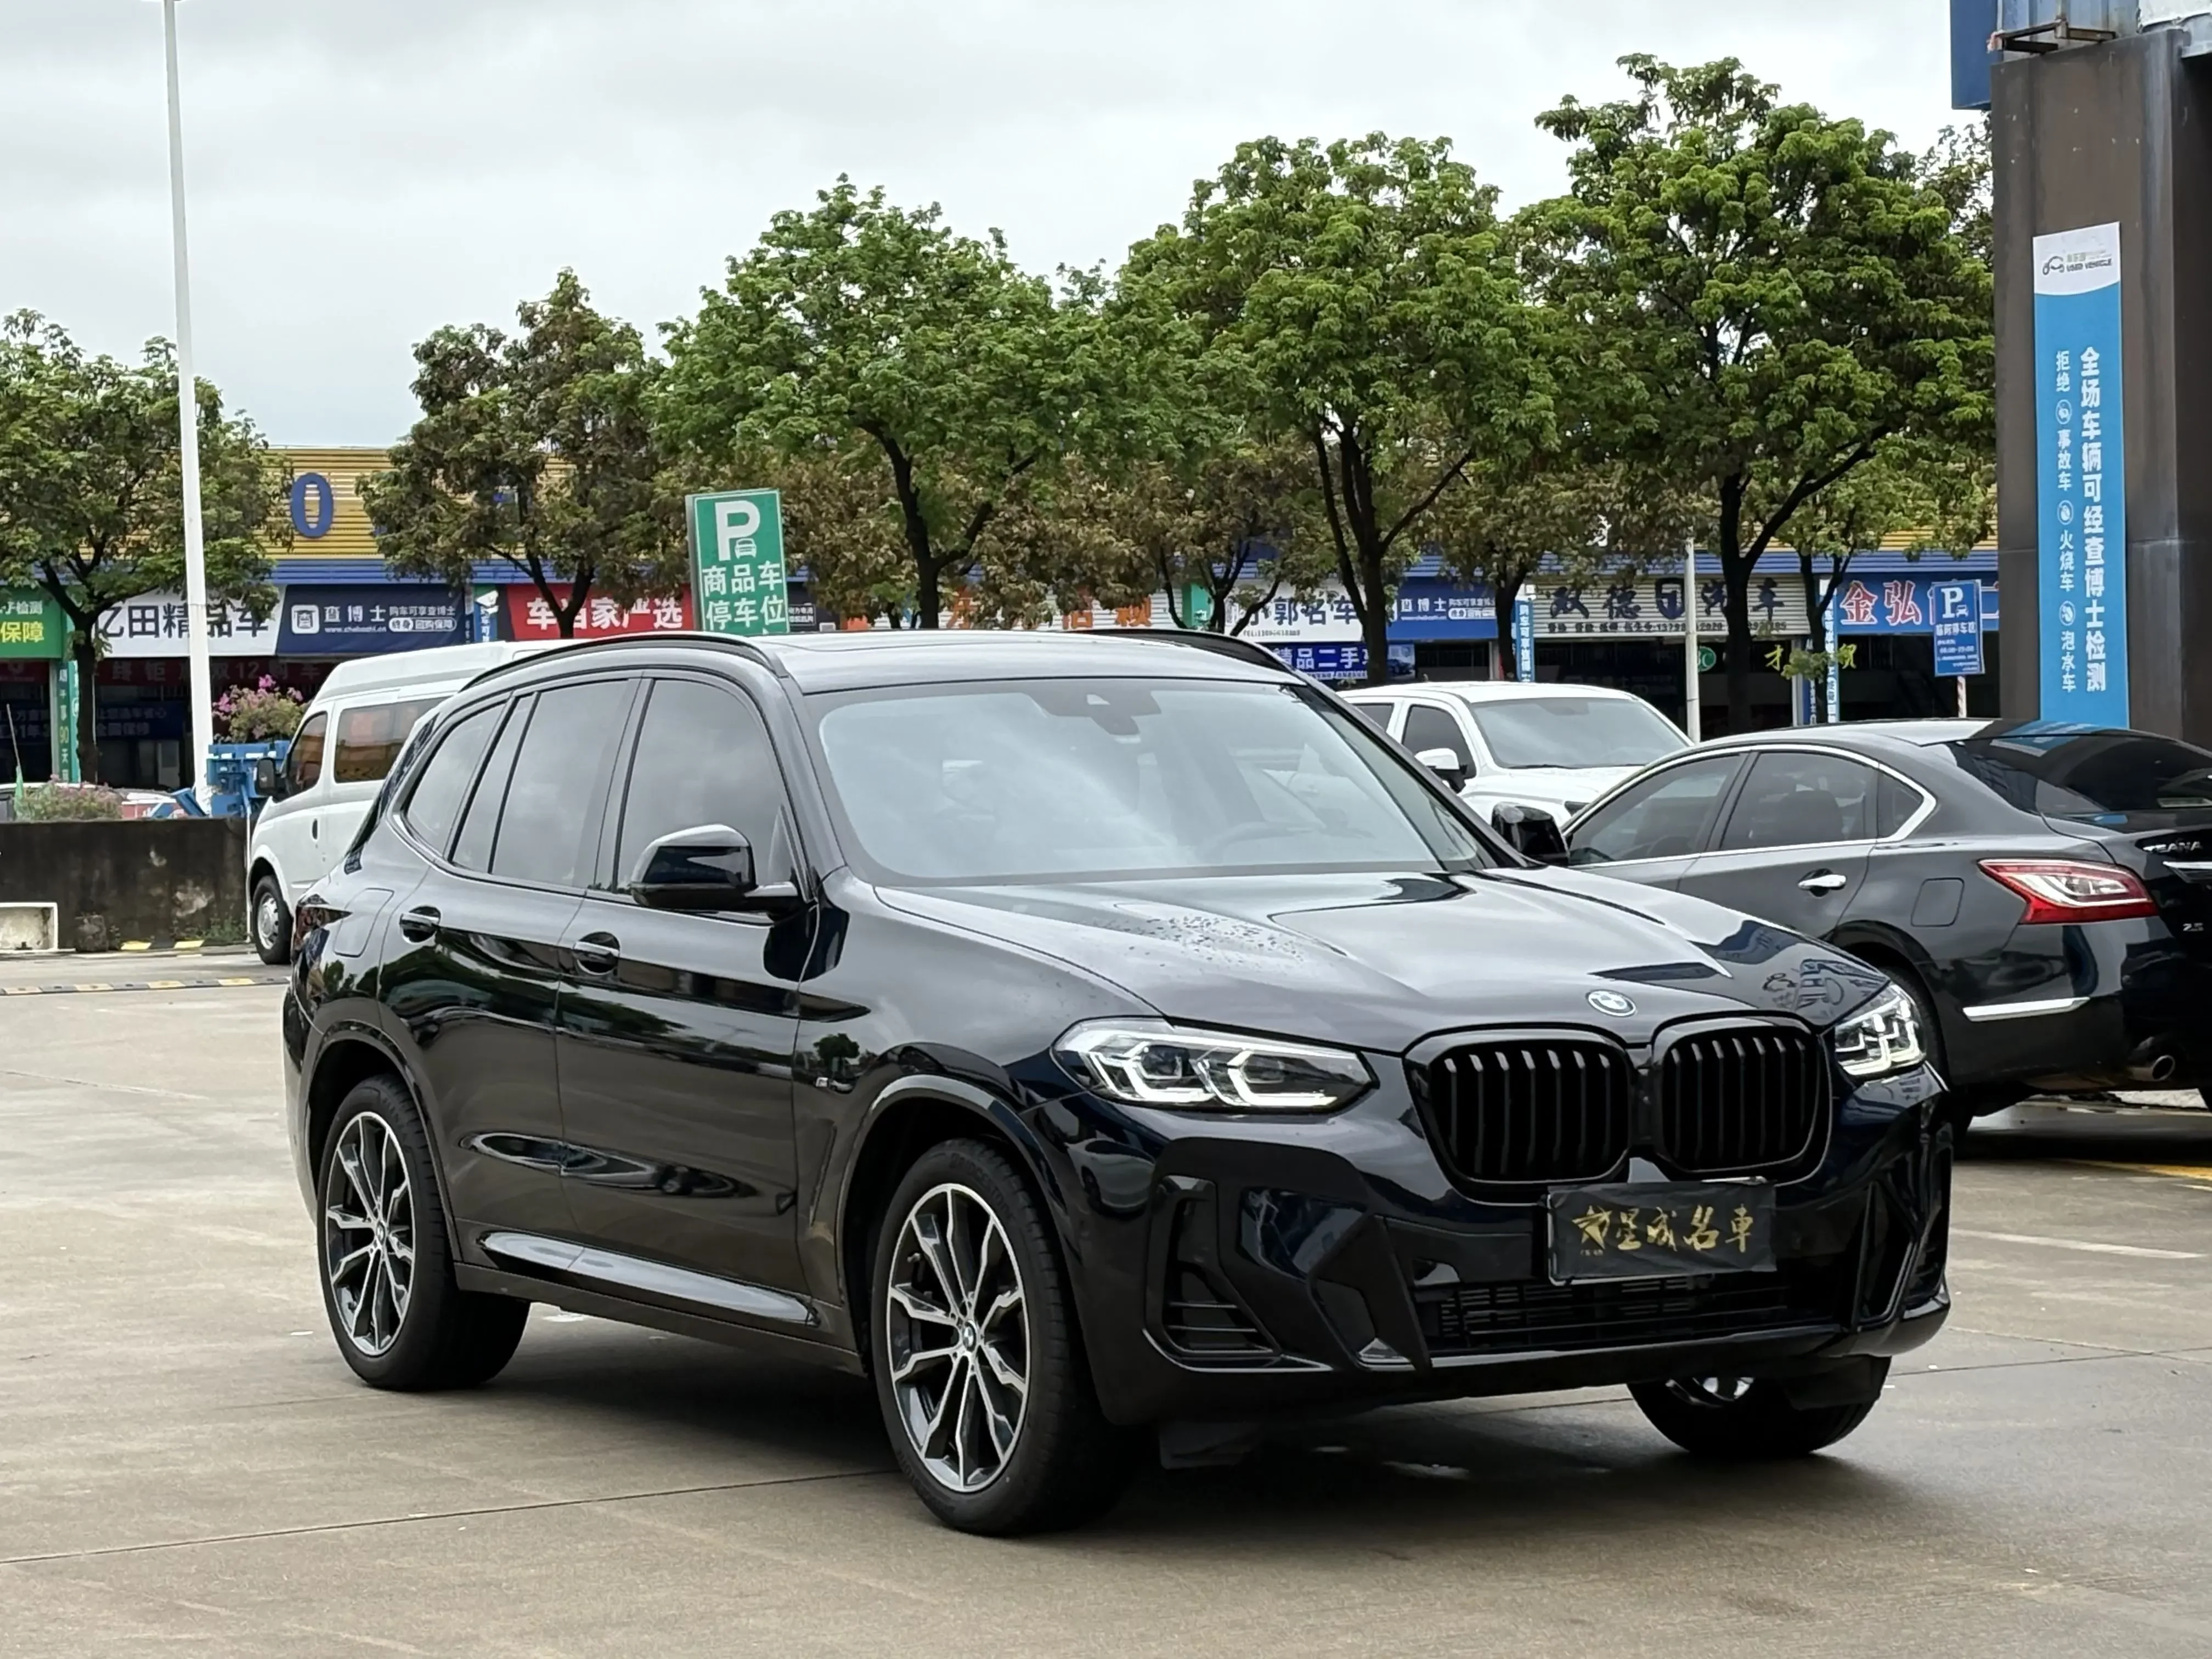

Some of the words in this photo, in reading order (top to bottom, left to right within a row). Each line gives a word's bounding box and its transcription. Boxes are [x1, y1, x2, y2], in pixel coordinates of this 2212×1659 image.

[2056, 350, 2070, 392] 拒绝
[715, 500, 760, 562] P
[2080, 346, 2106, 692] 全场车辆可经查博士检测
[702, 560, 782, 597] 商品车
[2059, 529, 2075, 592] 火烧车
[324, 605, 386, 623] 查博士
[706, 595, 786, 630] 停车位
[1401, 597, 1447, 612] 查博士
[1839, 579, 1935, 627] 金弘
[1940, 587, 1963, 619] P
[1, 621, 44, 643] 保障
